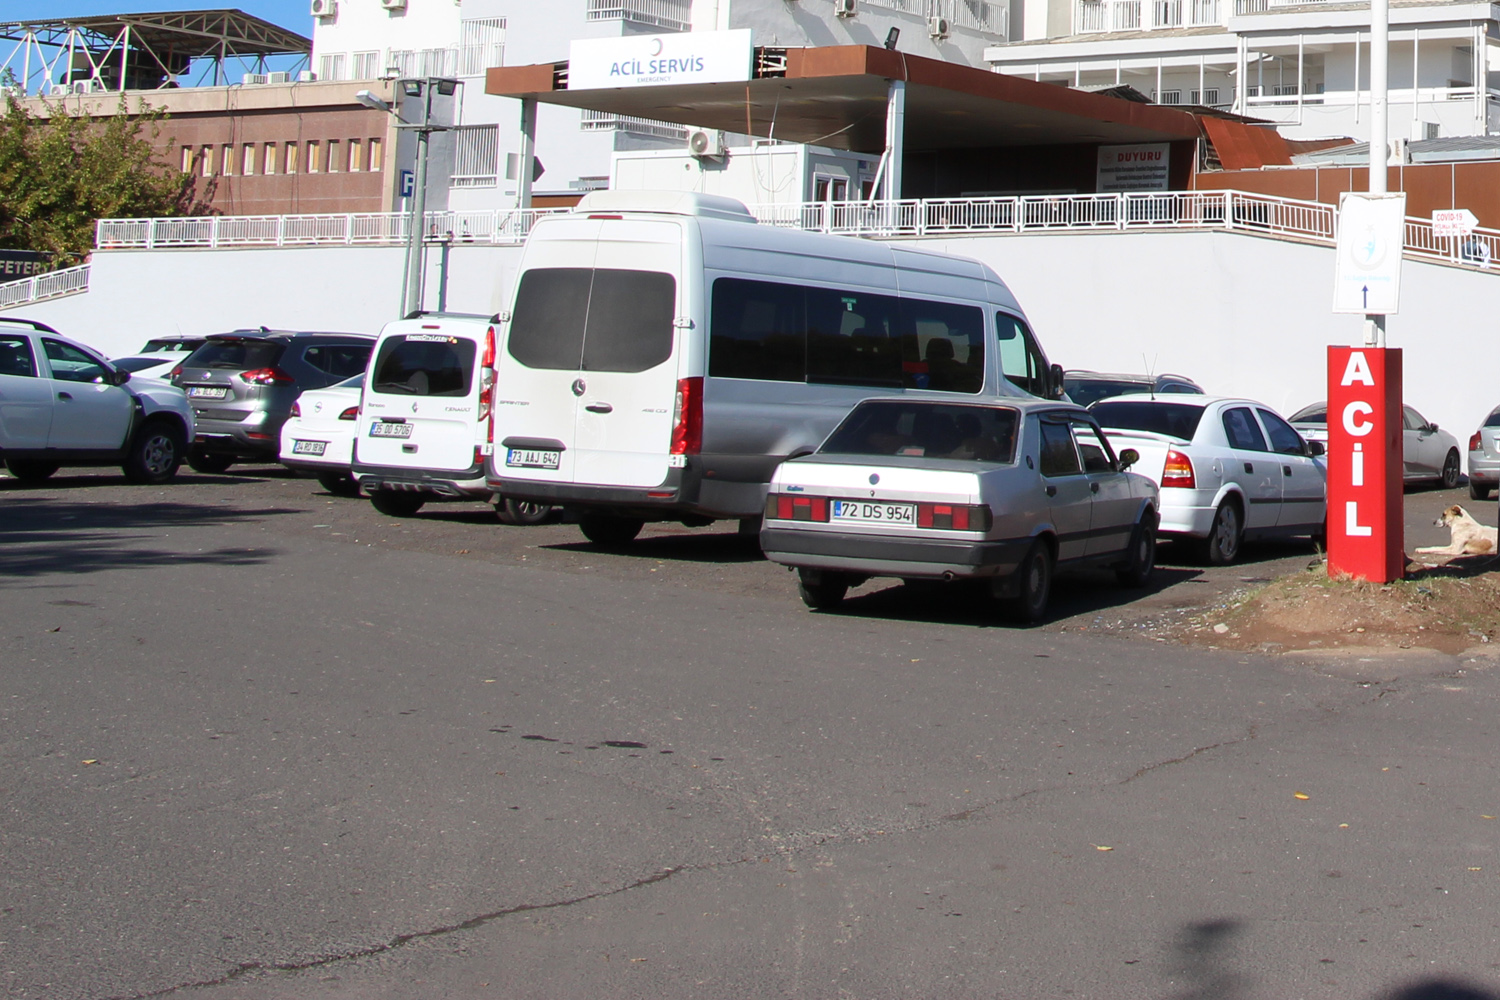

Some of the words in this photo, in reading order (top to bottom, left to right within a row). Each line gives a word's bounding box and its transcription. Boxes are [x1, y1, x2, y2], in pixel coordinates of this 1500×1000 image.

[611, 58, 644, 76] ACİL
[649, 56, 704, 74] SERVİS
[637, 75, 671, 83] EMERGENCY
[1117, 151, 1162, 162] DUYURU
[1340, 351, 1375, 536] ACİL
[512, 451, 522, 462] 73
[525, 451, 540, 463] AAJ
[543, 452, 557, 464] 642
[842, 503, 858, 517] 72
[863, 504, 882, 518] DS
[886, 506, 910, 521] 954
